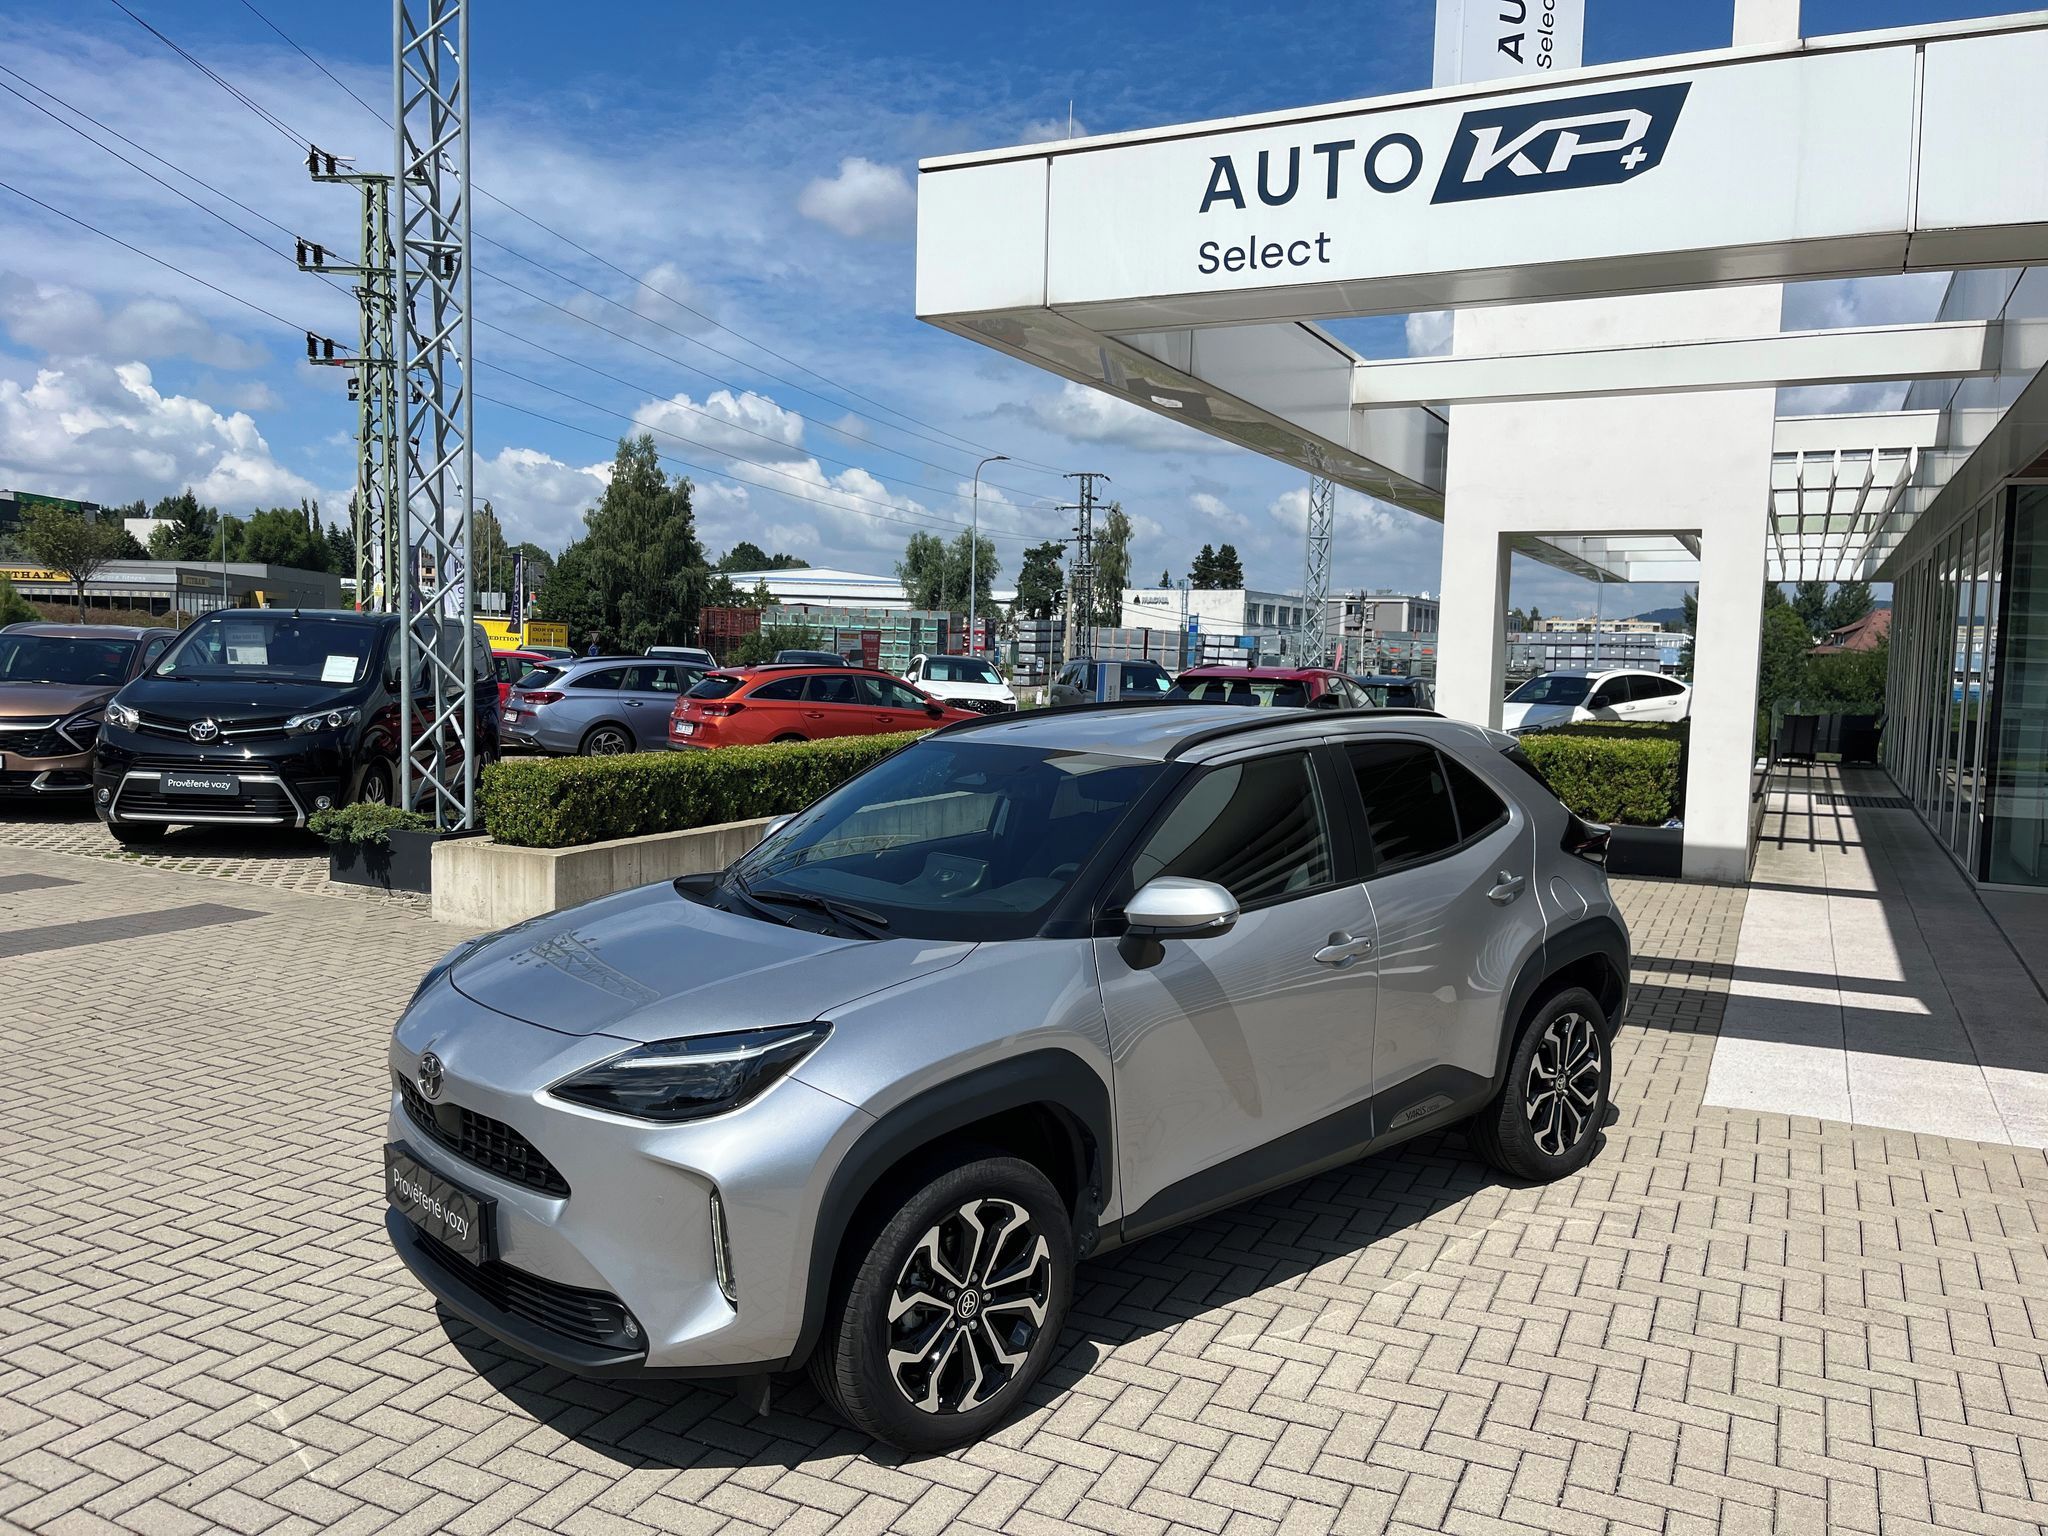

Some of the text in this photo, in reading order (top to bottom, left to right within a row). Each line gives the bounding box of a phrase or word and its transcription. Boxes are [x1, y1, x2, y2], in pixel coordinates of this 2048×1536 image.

[1198, 132, 1424, 213] AUTO
[1197, 231, 1331, 275] Select
[167, 778, 231, 790] Prověřené vozy
[393, 1168, 469, 1240] Prověřené vozy
